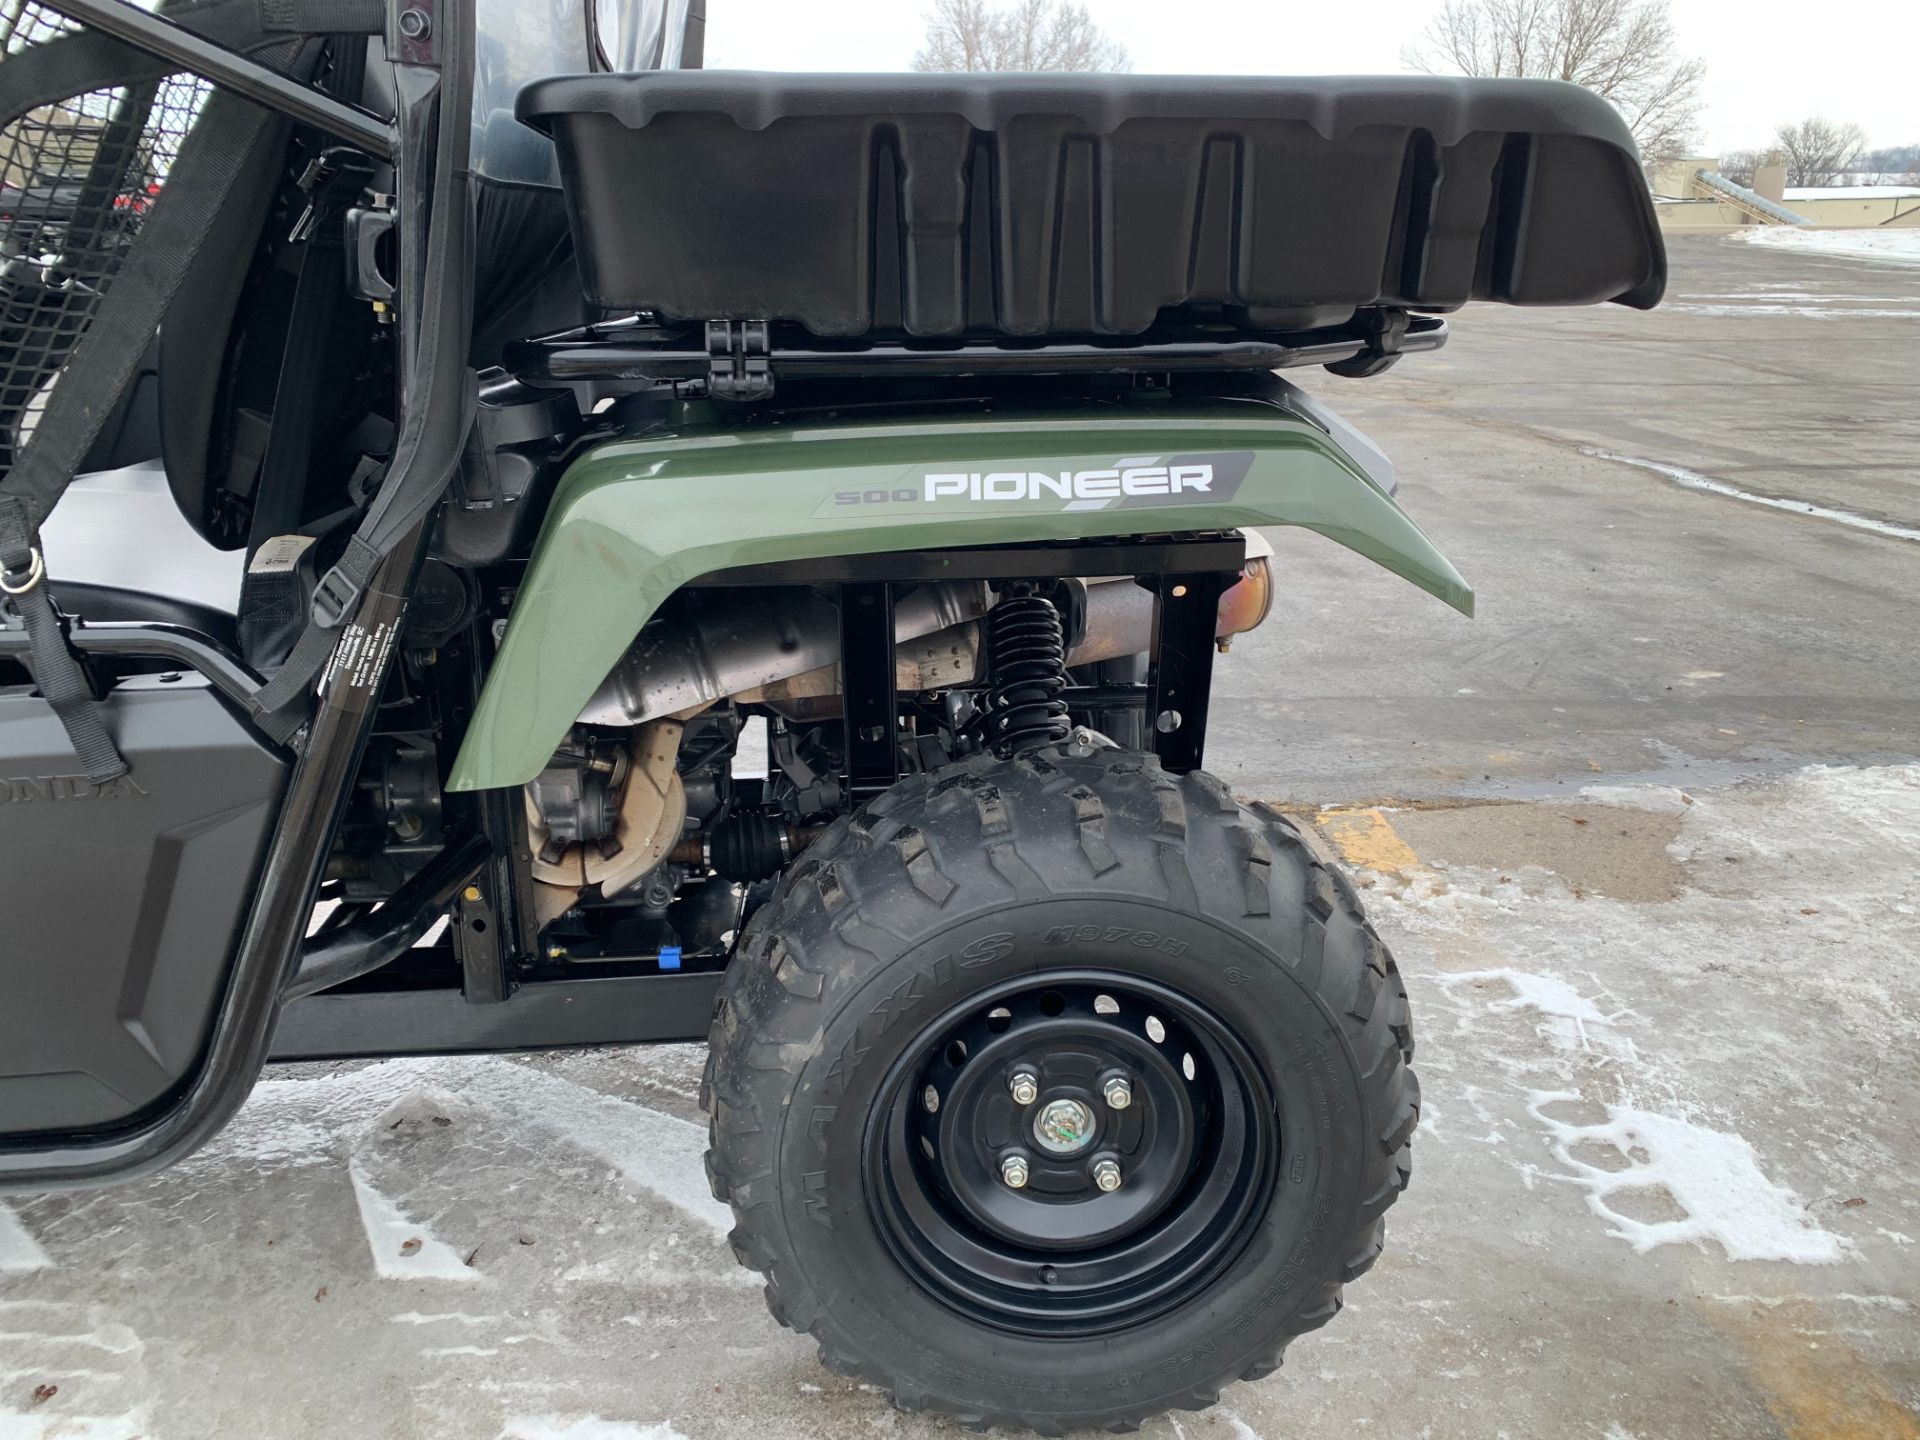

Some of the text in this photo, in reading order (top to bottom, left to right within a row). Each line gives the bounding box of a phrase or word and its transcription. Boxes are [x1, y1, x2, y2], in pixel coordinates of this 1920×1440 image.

[834, 465, 1214, 506] 500 PIONEER
[356, 626, 365, 636] SC
[802, 924, 1189, 1230] MAXXIS M978H
